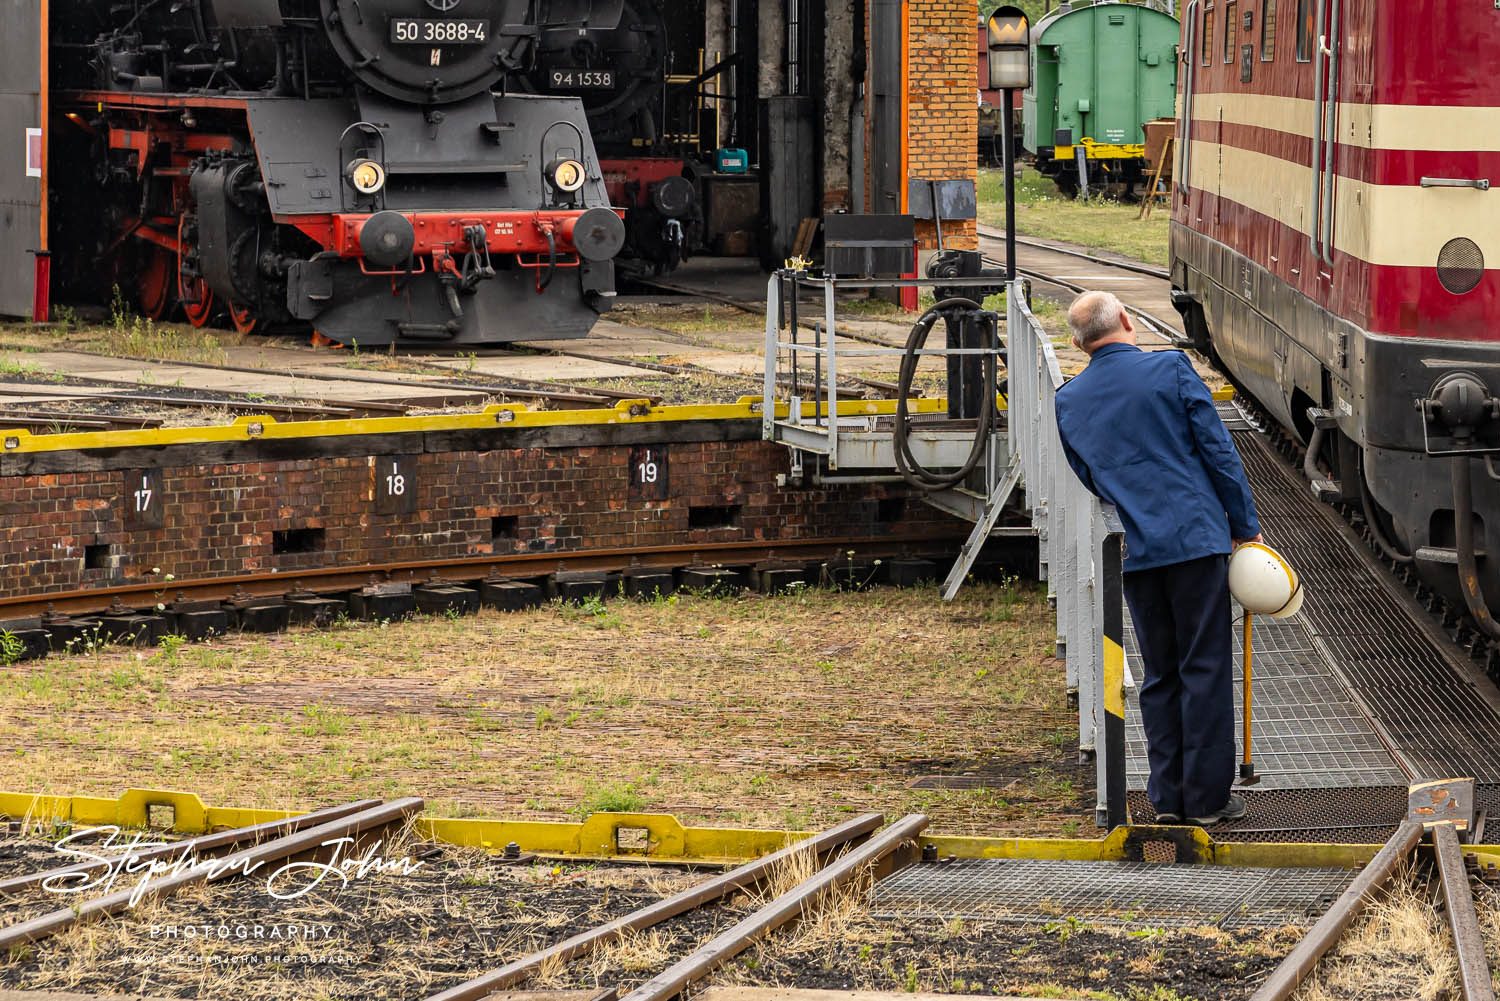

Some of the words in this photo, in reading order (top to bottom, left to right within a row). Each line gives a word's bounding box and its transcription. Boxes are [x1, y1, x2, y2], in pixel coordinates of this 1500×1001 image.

[396, 22, 418, 40] 50
[424, 22, 485, 41] 3688-4
[553, 72, 572, 86] 94
[578, 73, 611, 86] 1538
[637, 461, 658, 483] 19
[386, 475, 405, 496] 18
[134, 489, 152, 511] 17
